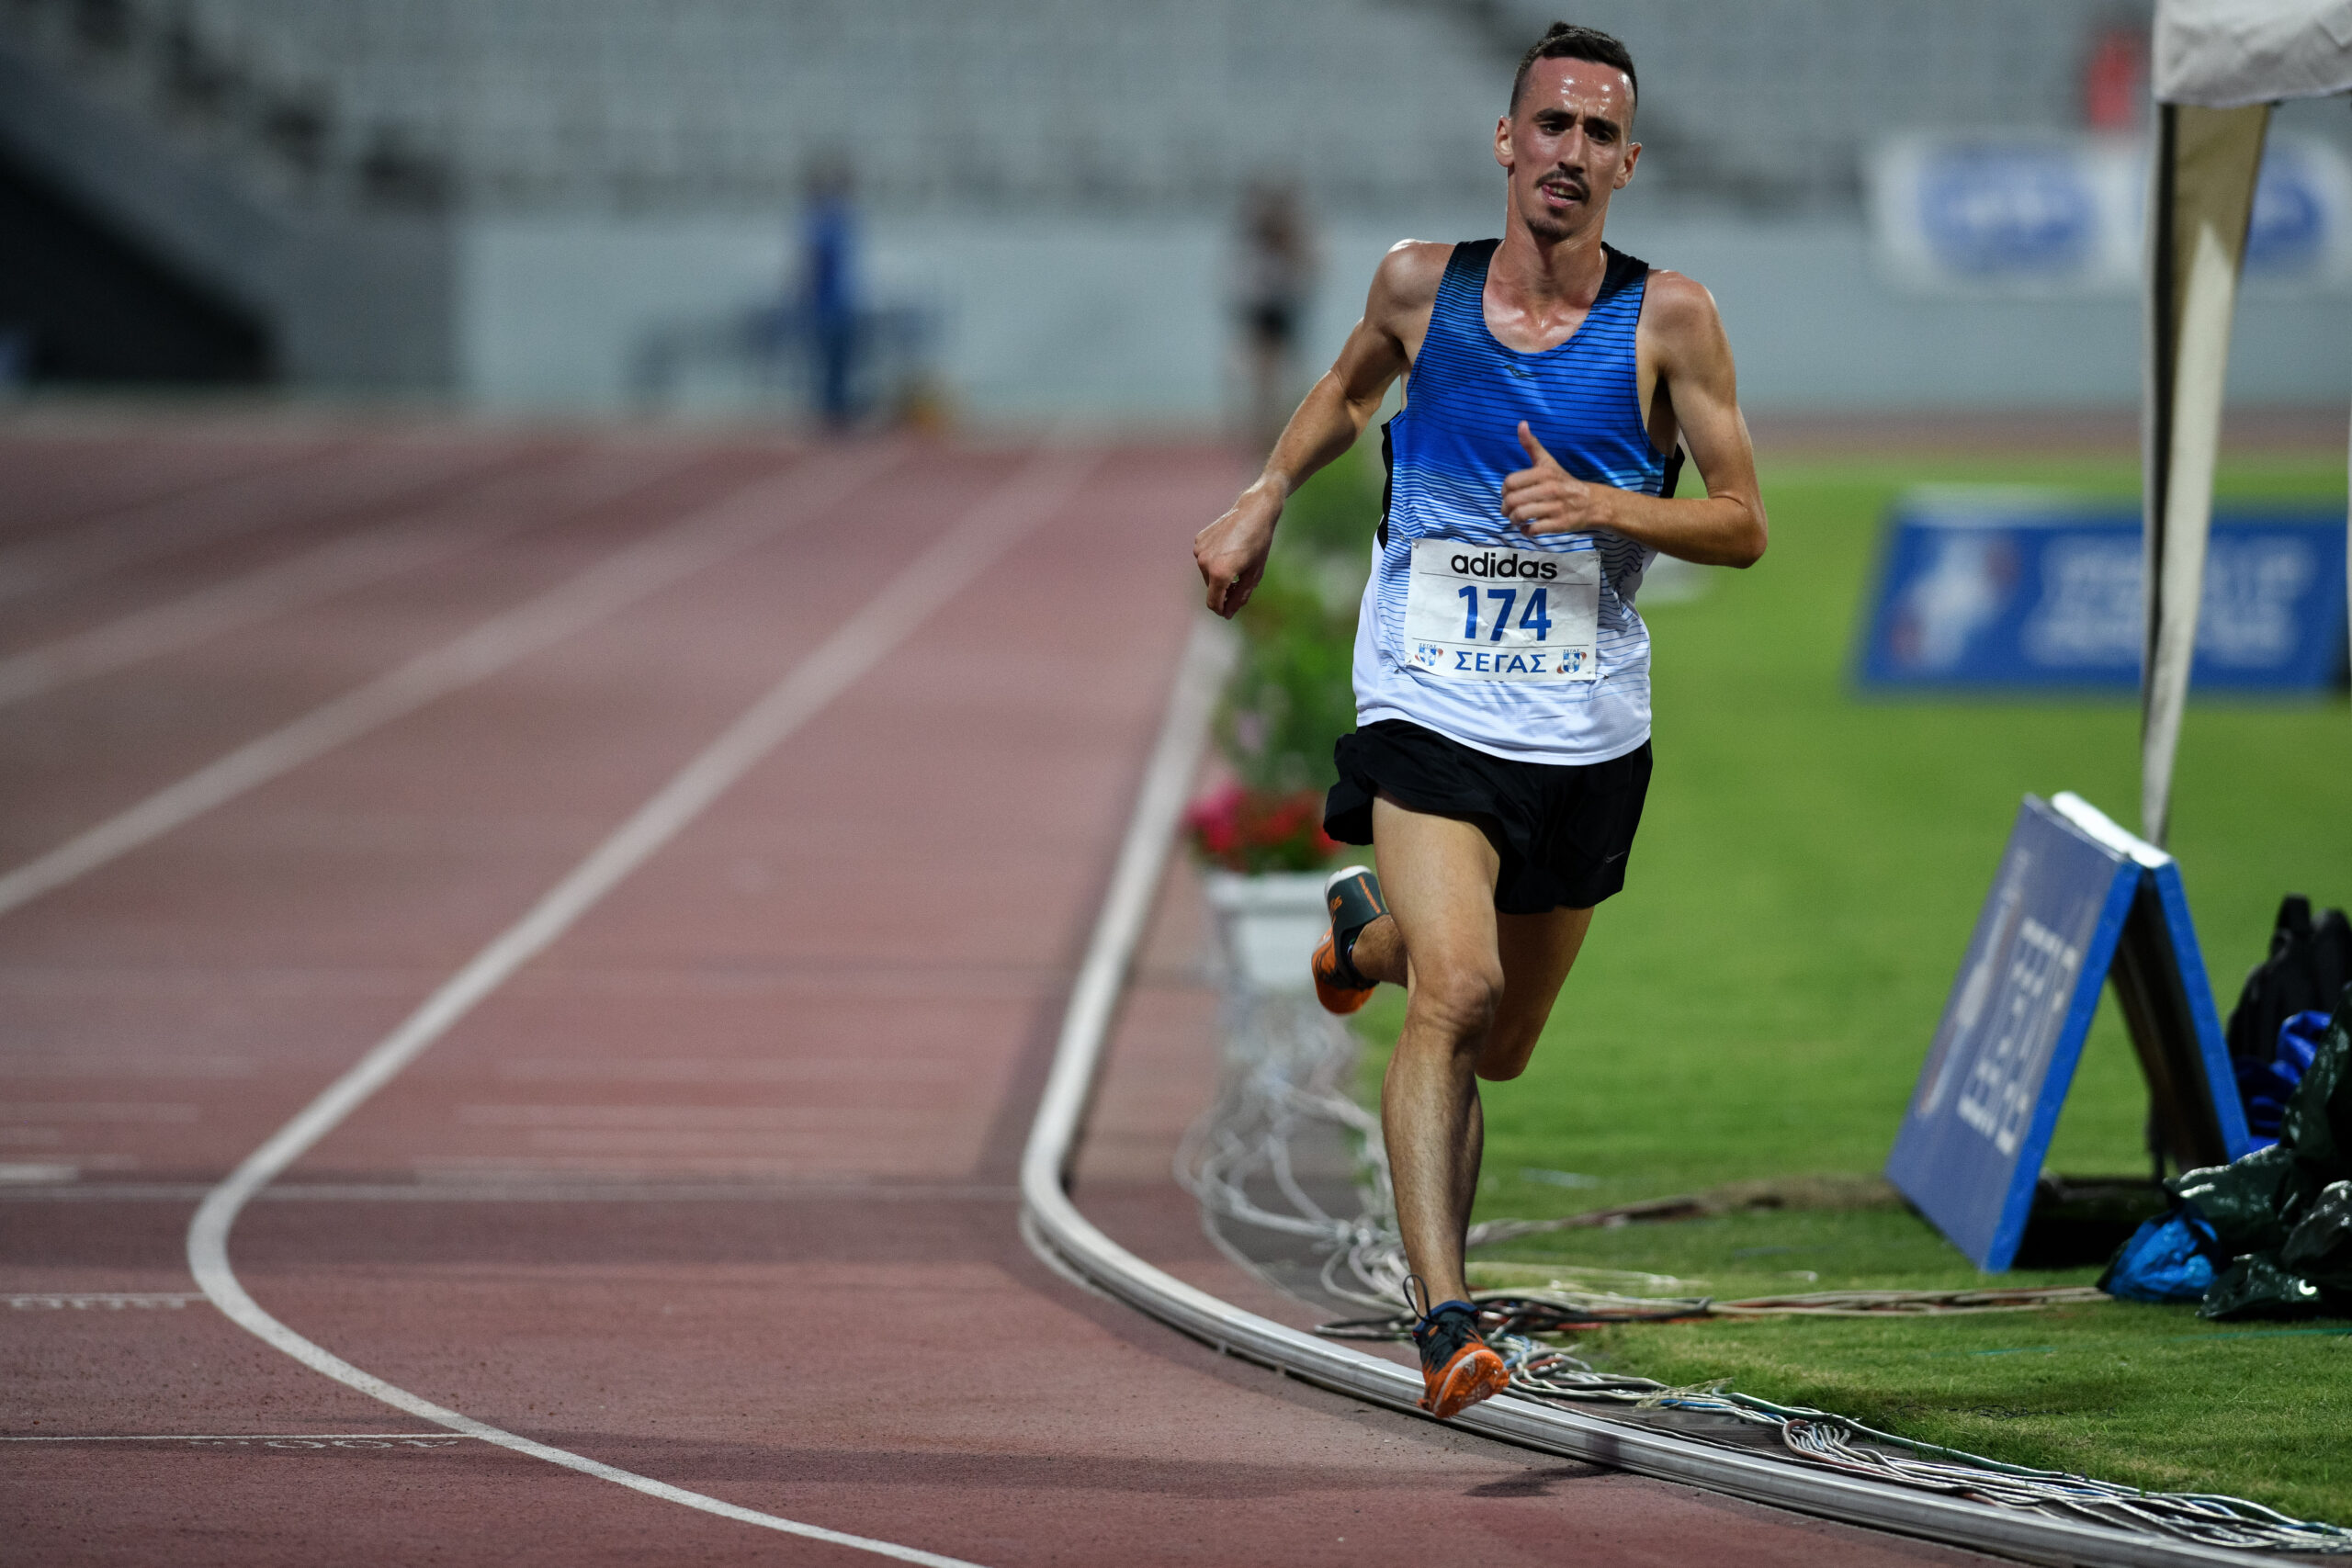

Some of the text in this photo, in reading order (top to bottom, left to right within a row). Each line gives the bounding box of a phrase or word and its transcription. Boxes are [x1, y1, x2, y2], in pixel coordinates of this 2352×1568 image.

[1451, 552, 1557, 579] adidas
[1458, 585, 1552, 641] 174
[1454, 650, 1546, 673] ΣΕΓΑΣ
